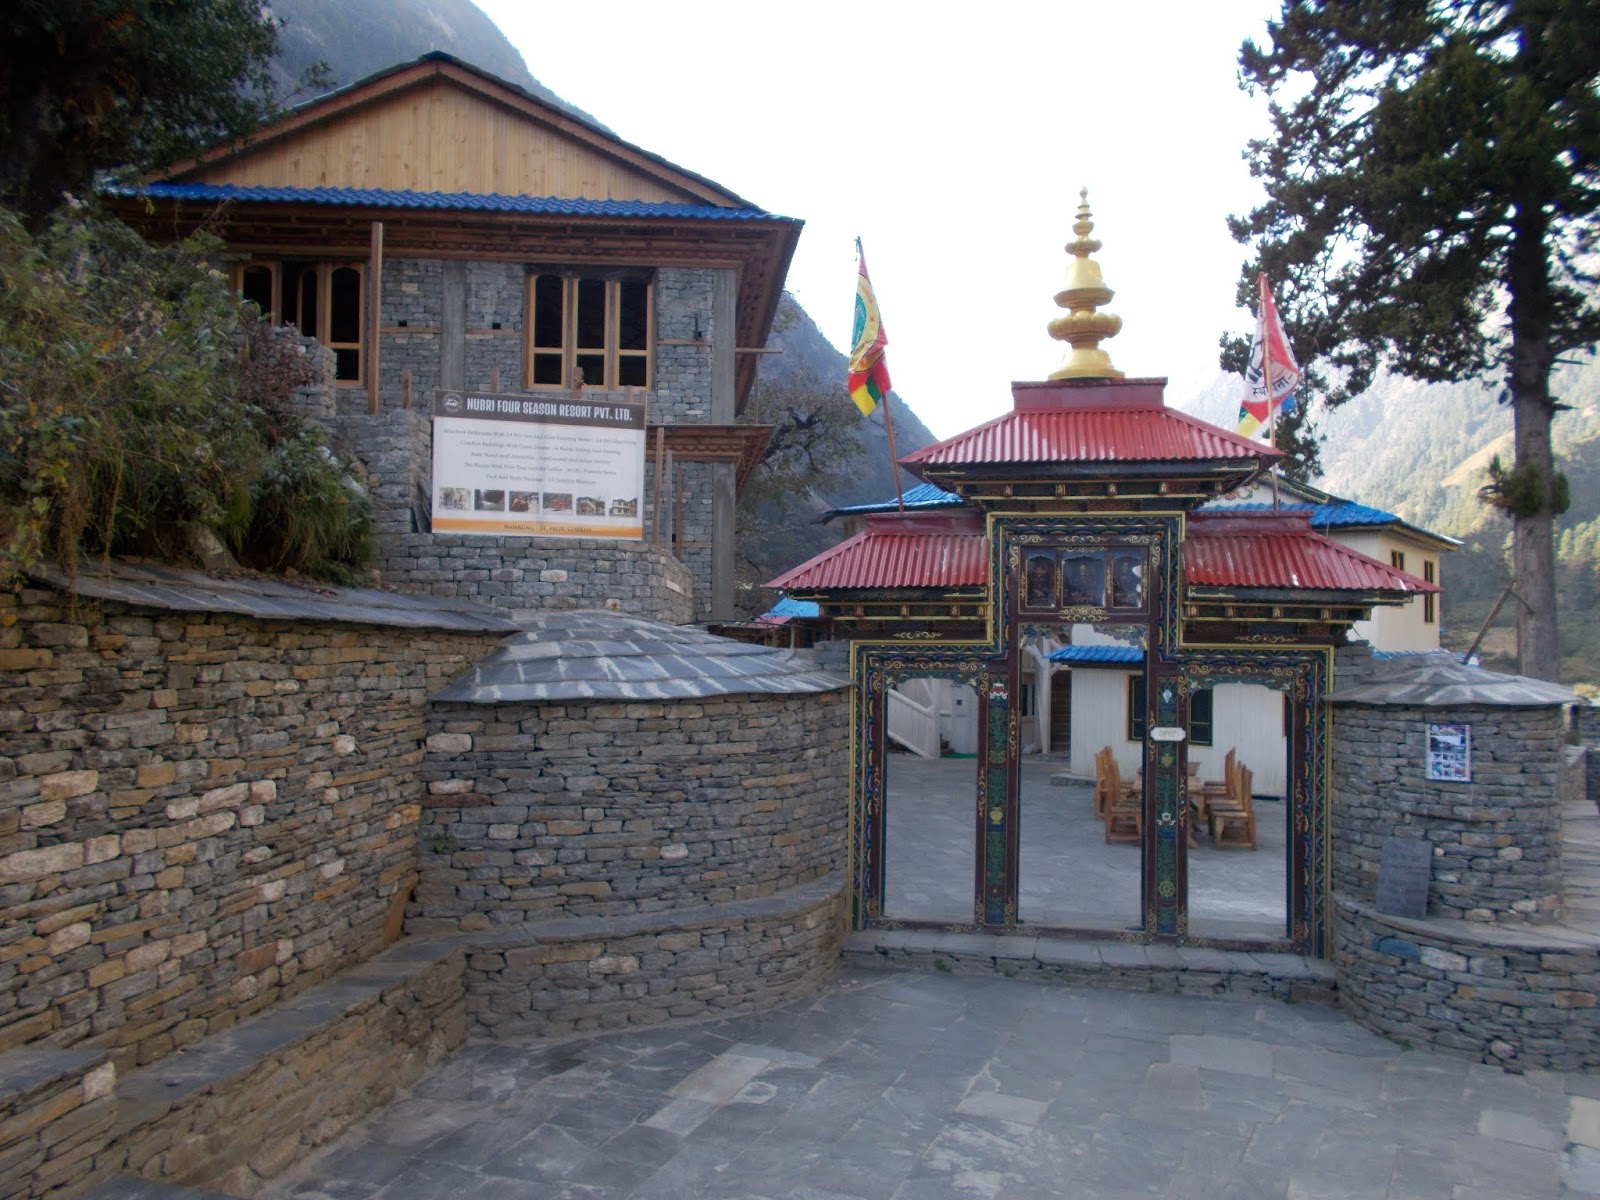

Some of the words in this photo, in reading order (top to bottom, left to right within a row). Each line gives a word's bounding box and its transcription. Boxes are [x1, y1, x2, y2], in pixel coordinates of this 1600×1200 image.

[467, 397, 495, 412] NUBRI
[497, 399, 521, 413] FOUR
[522, 401, 557, 416] SEASON
[559, 404, 592, 418] RESORT
[593, 406, 613, 420] PVT.
[614, 408, 633, 421] LTD.
